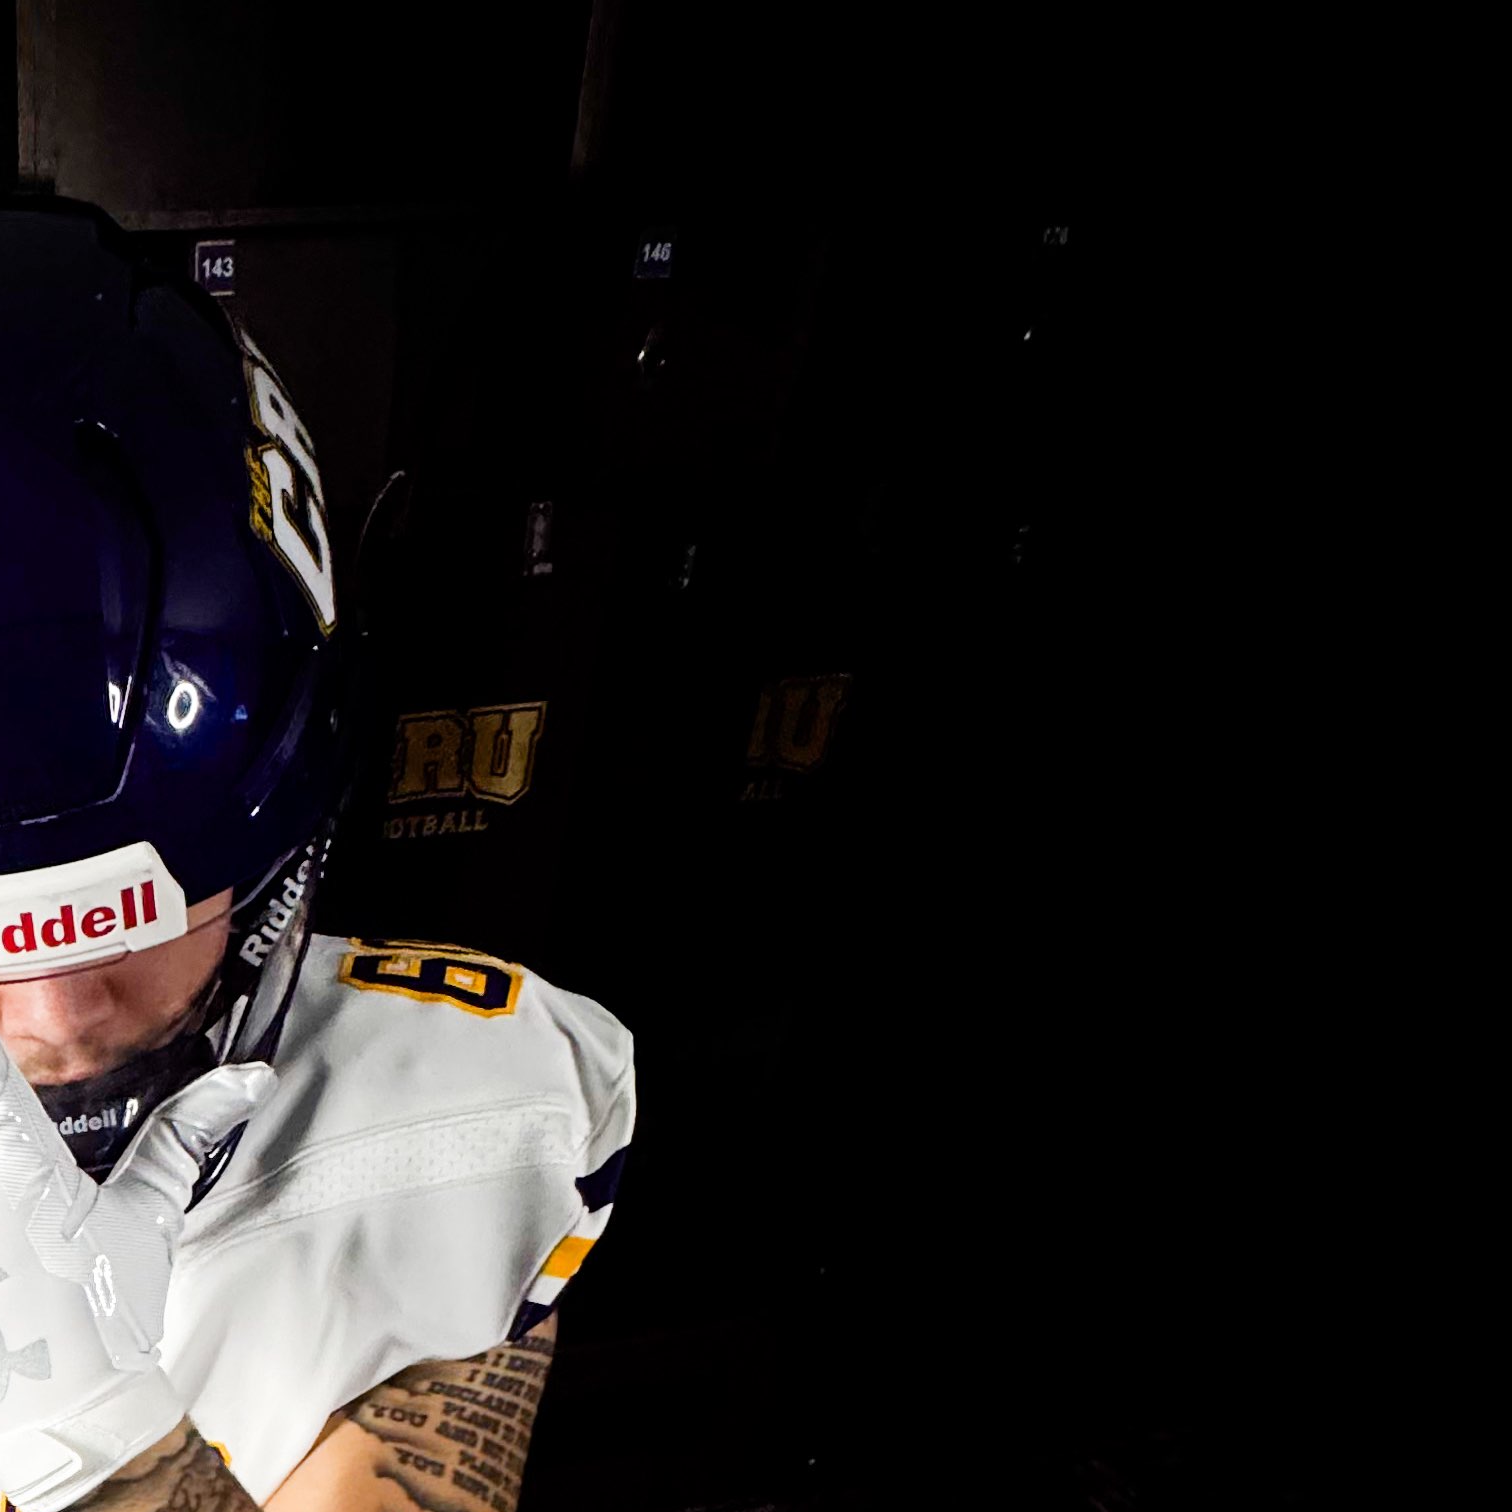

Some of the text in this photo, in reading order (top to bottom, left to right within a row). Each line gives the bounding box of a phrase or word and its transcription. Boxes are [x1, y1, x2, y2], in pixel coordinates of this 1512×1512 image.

[202, 256, 234, 278] 143
[387, 700, 547, 806] RU
[383, 808, 489, 840] OTBALL
[57, 1108, 118, 1136] ddell
